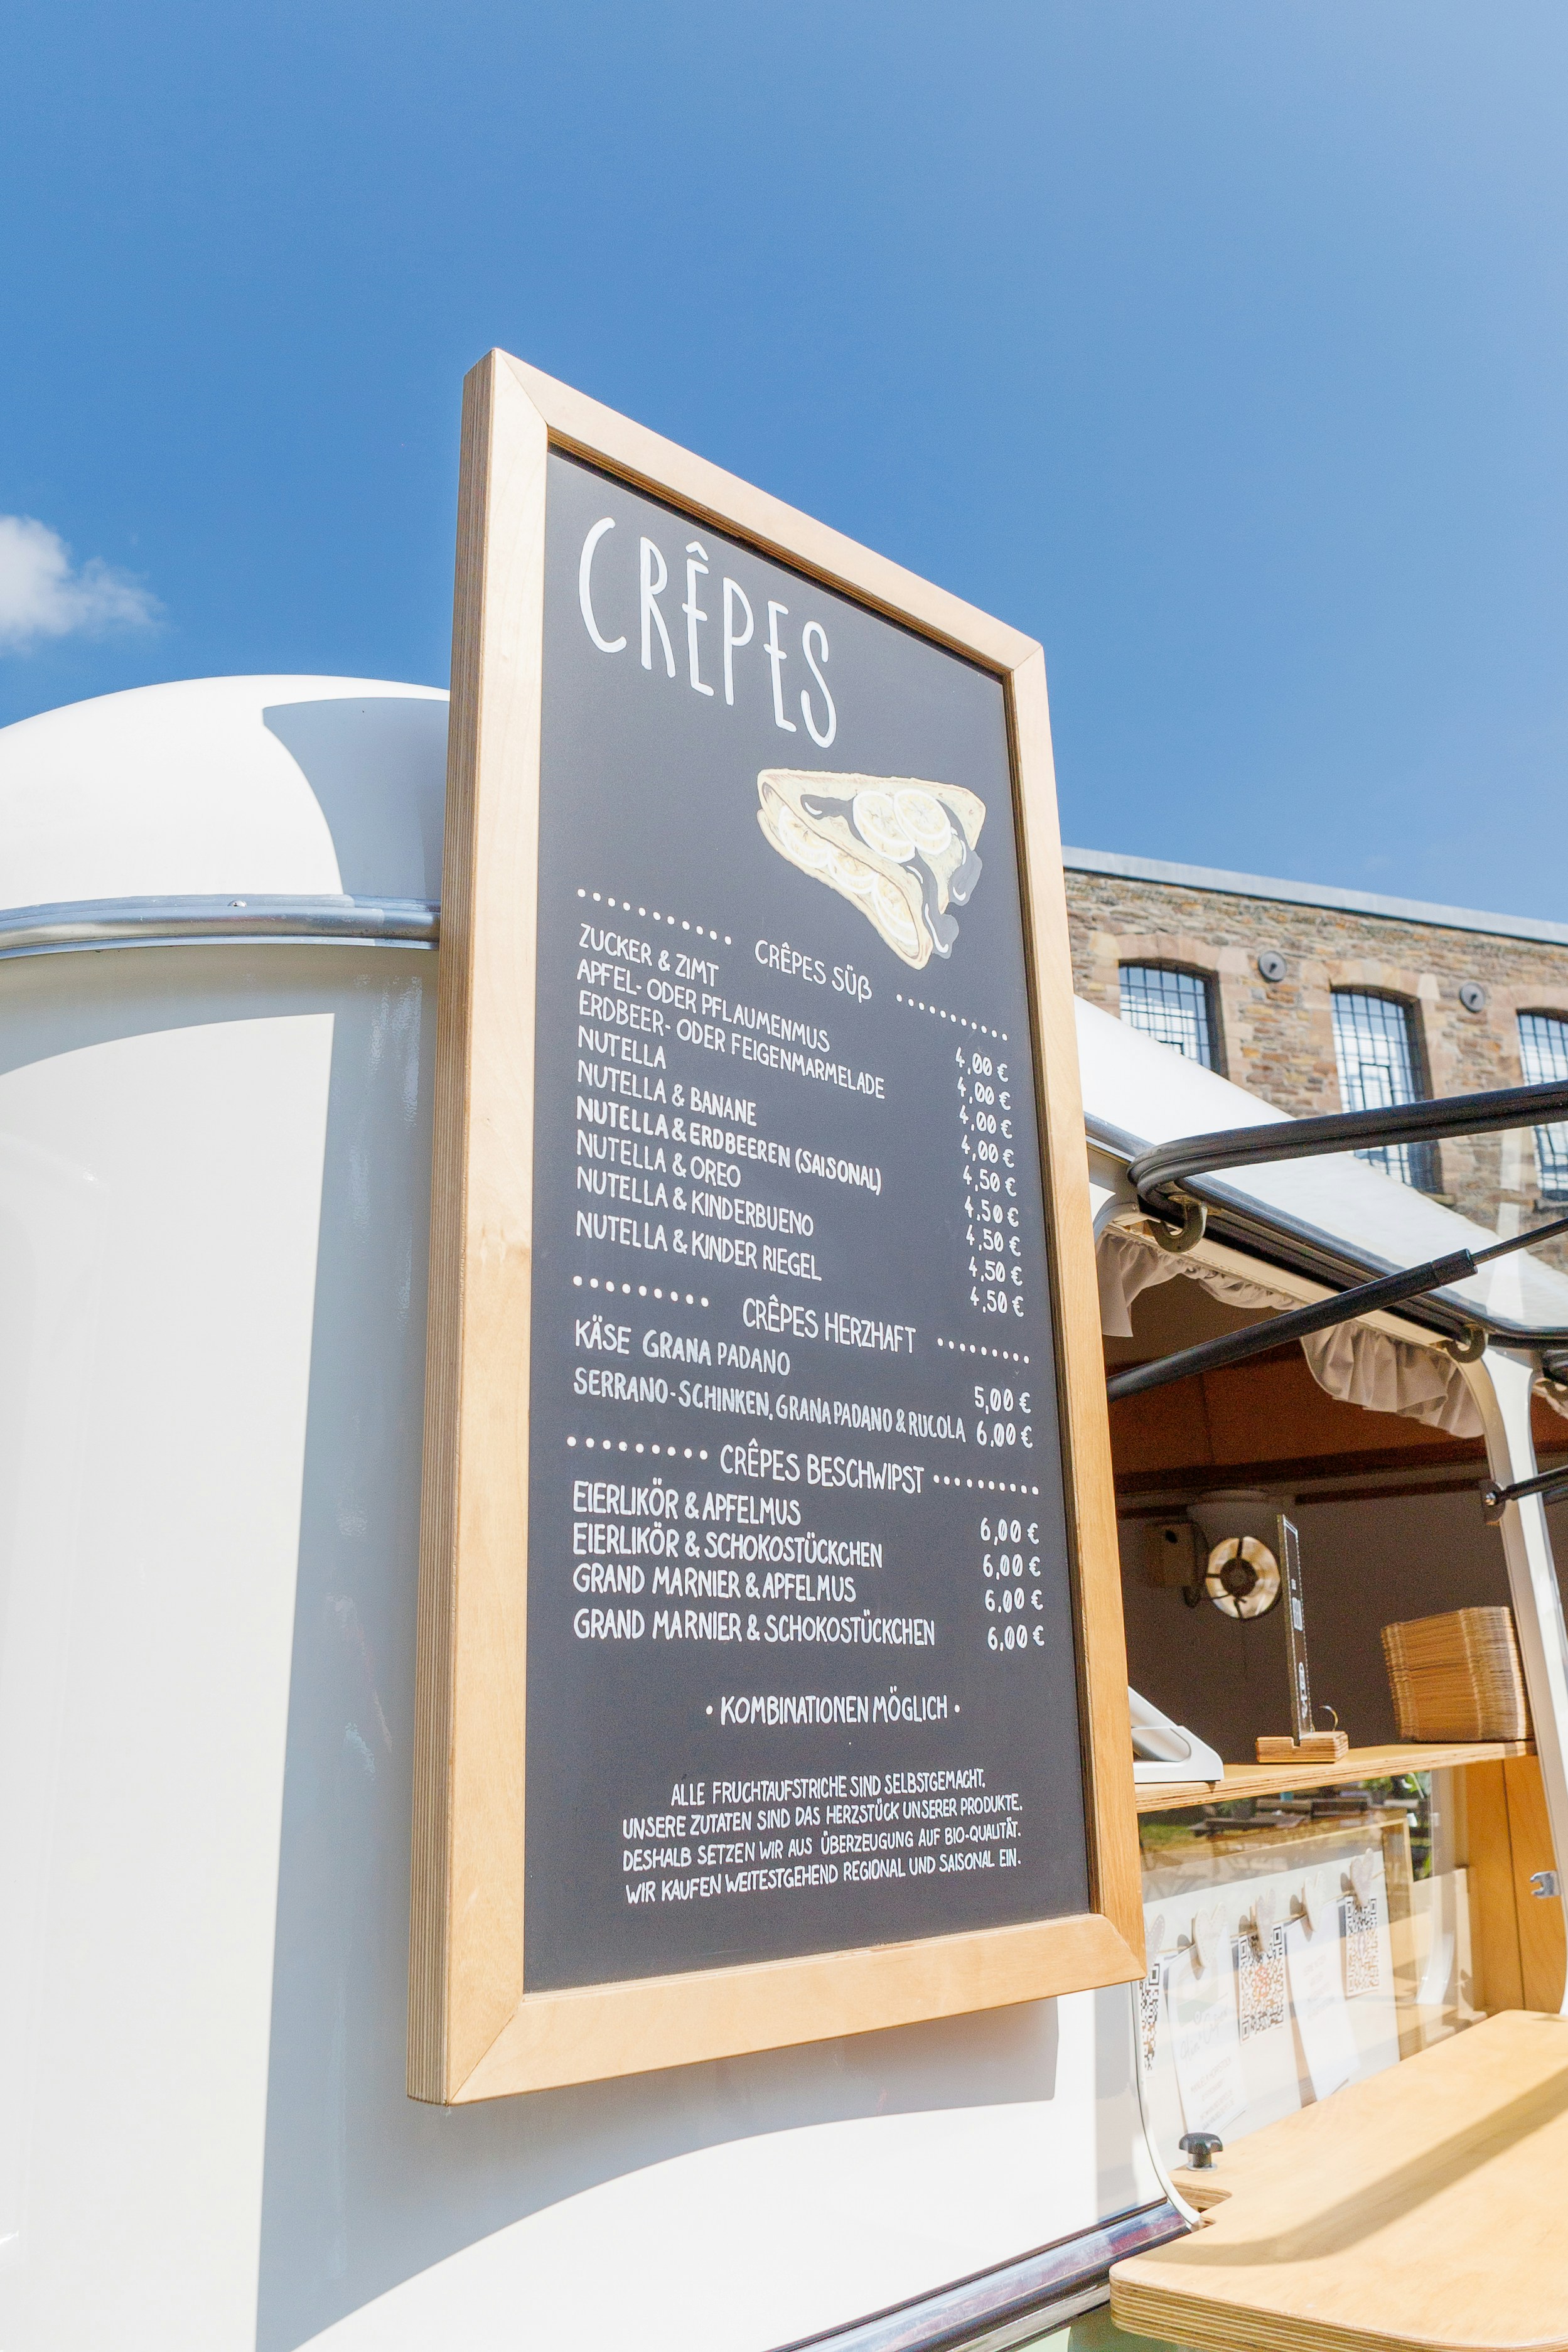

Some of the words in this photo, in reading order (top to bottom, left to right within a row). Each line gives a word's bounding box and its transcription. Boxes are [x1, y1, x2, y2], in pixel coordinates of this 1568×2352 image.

[577, 516, 837, 749] CRÊPES
[579, 923, 653, 967] ZUCKER
[658, 949, 671, 972] &
[675, 953, 719, 987] ZIMT
[754, 940, 827, 985] CRÊPES
[831, 964, 873, 1004] SÜß
[576, 959, 642, 996] APFEL-
[647, 978, 697, 1014] ODER
[702, 993, 830, 1053] PFLAUMENMUS
[577, 1024, 667, 1070] NUTELLA
[579, 989, 671, 1037] ERDBEER-
[676, 1018, 726, 1053] ODER
[731, 1033, 885, 1100] FEIGENMARMELADE
[955, 1046, 993, 1077] 4,00
[996, 1063, 1009, 1083] €
[577, 1059, 667, 1104] NUTELLA
[671, 1083, 685, 1107] &
[690, 1087, 757, 1127] BANANE
[957, 1076, 995, 1105] 4,00
[998, 1091, 1011, 1111] €
[959, 1104, 997, 1134] 4,00
[1000, 1119, 1013, 1139] €
[576, 1095, 670, 1140] NUTELLA
[671, 1117, 687, 1143] &
[689, 1122, 791, 1168] ERDBEEREN
[795, 1147, 881, 1196] (SAISONAL)
[576, 1129, 667, 1173] NUTELLA
[672, 1152, 687, 1178] &
[690, 1156, 741, 1188] OREO
[961, 1134, 999, 1164] 4,00
[1002, 1148, 1015, 1168] €
[577, 1166, 669, 1208] NUTELLA
[672, 1186, 687, 1211] &
[691, 1189, 814, 1237] KINDERBUENO
[962, 1164, 1001, 1193] 4,50
[1004, 1177, 1017, 1197] €
[964, 1195, 1004, 1224] 4,50
[1007, 1206, 1019, 1228] €
[576, 1210, 669, 1252] NUTELLA
[672, 1228, 688, 1255] &
[691, 1233, 758, 1270] KINDER
[763, 1244, 822, 1282] RIEGEL
[965, 1224, 1004, 1252] 4,50
[1009, 1235, 1021, 1257] €
[968, 1255, 1006, 1282] 4,50
[1010, 1265, 1023, 1286] €
[743, 1294, 819, 1339] CRÊPES
[824, 1311, 916, 1354] HERZHAFT
[970, 1286, 1008, 1314] 4,50
[1011, 1295, 1024, 1318] €
[575, 1314, 632, 1355] KÄSE
[642, 1329, 712, 1367] GRANA
[717, 1341, 791, 1376] PADANO
[775, 1393, 832, 1425] GRANA
[833, 1400, 893, 1433] PADANO
[895, 1408, 906, 1434] &
[908, 1411, 967, 1443] RUCOLA
[974, 1385, 1014, 1415] 5,00
[1019, 1392, 1031, 1414] €
[976, 1420, 1016, 1447] 6,00
[1020, 1425, 1033, 1449] €
[720, 1437, 801, 1482] CRÊPES
[807, 1453, 925, 1495] BESCHWIPST
[573, 1478, 679, 1520] EIERLIKÖR
[684, 1491, 700, 1520] &
[702, 1491, 802, 1526] APFELMUS
[572, 1521, 680, 1558] EIERLIKÖR
[684, 1530, 701, 1559] &
[704, 1531, 883, 1569] SCHOKOSTÜCKCHEN
[980, 1517, 1022, 1546] 6,00
[1026, 1522, 1039, 1545] €
[572, 1562, 645, 1594] GRAND
[652, 1565, 741, 1599] MARNIER
[745, 1571, 761, 1599] &
[761, 1572, 857, 1603] APFELMUS
[982, 1554, 1023, 1581] 6,00
[1028, 1555, 1041, 1577] €
[984, 1587, 1025, 1613] 6,00
[1031, 1589, 1044, 1611] €
[573, 1608, 645, 1640] GRAND
[652, 1609, 743, 1643] MARNIER
[746, 1614, 761, 1641] &
[763, 1609, 935, 1646] SCHOKOSTÜCKCHEN
[987, 1624, 1028, 1652] 6,00
[1032, 1624, 1045, 1646] €
[720, 1695, 869, 1726] KOMBINATIONEN
[873, 1685, 948, 1724] MÖGLICH
[670, 1782, 706, 1807] ALLE
[712, 1775, 847, 1805] FRUCHTAUFSTRICHE
[849, 1775, 881, 1798] SIND
[884, 1768, 986, 1795] SELBSTGEMACHT.
[623, 1815, 687, 1840] UNSERE
[689, 1810, 752, 1836] ZUTATEN
[756, 1808, 791, 1831] SIND
[795, 1805, 821, 1827] DAS
[826, 1797, 900, 1825] HERZSTÜCK
[902, 1797, 958, 1820] UNSERER
[960, 1793, 1023, 1817] PRODUKTE.
[623, 1847, 692, 1872] DESHALB
[697, 1841, 756, 1866] SETZEN
[759, 1839, 784, 1861] WIR
[788, 1837, 813, 1858] AUS
[820, 1830, 914, 1855] ÜBERZEUGUNG
[918, 1827, 941, 1847] AUF
[944, 1816, 1021, 1845] BIO-QUALITÄT.
[625, 1881, 656, 1904] WIR
[661, 1872, 722, 1902] KAUFEN
[724, 1864, 839, 1893] WEITESTGEHEND
[843, 1857, 906, 1882] REGIONAL
[908, 1855, 936, 1876] UND
[938, 1849, 996, 1873] SAISONAL
[999, 1847, 1021, 1867] EIN.
